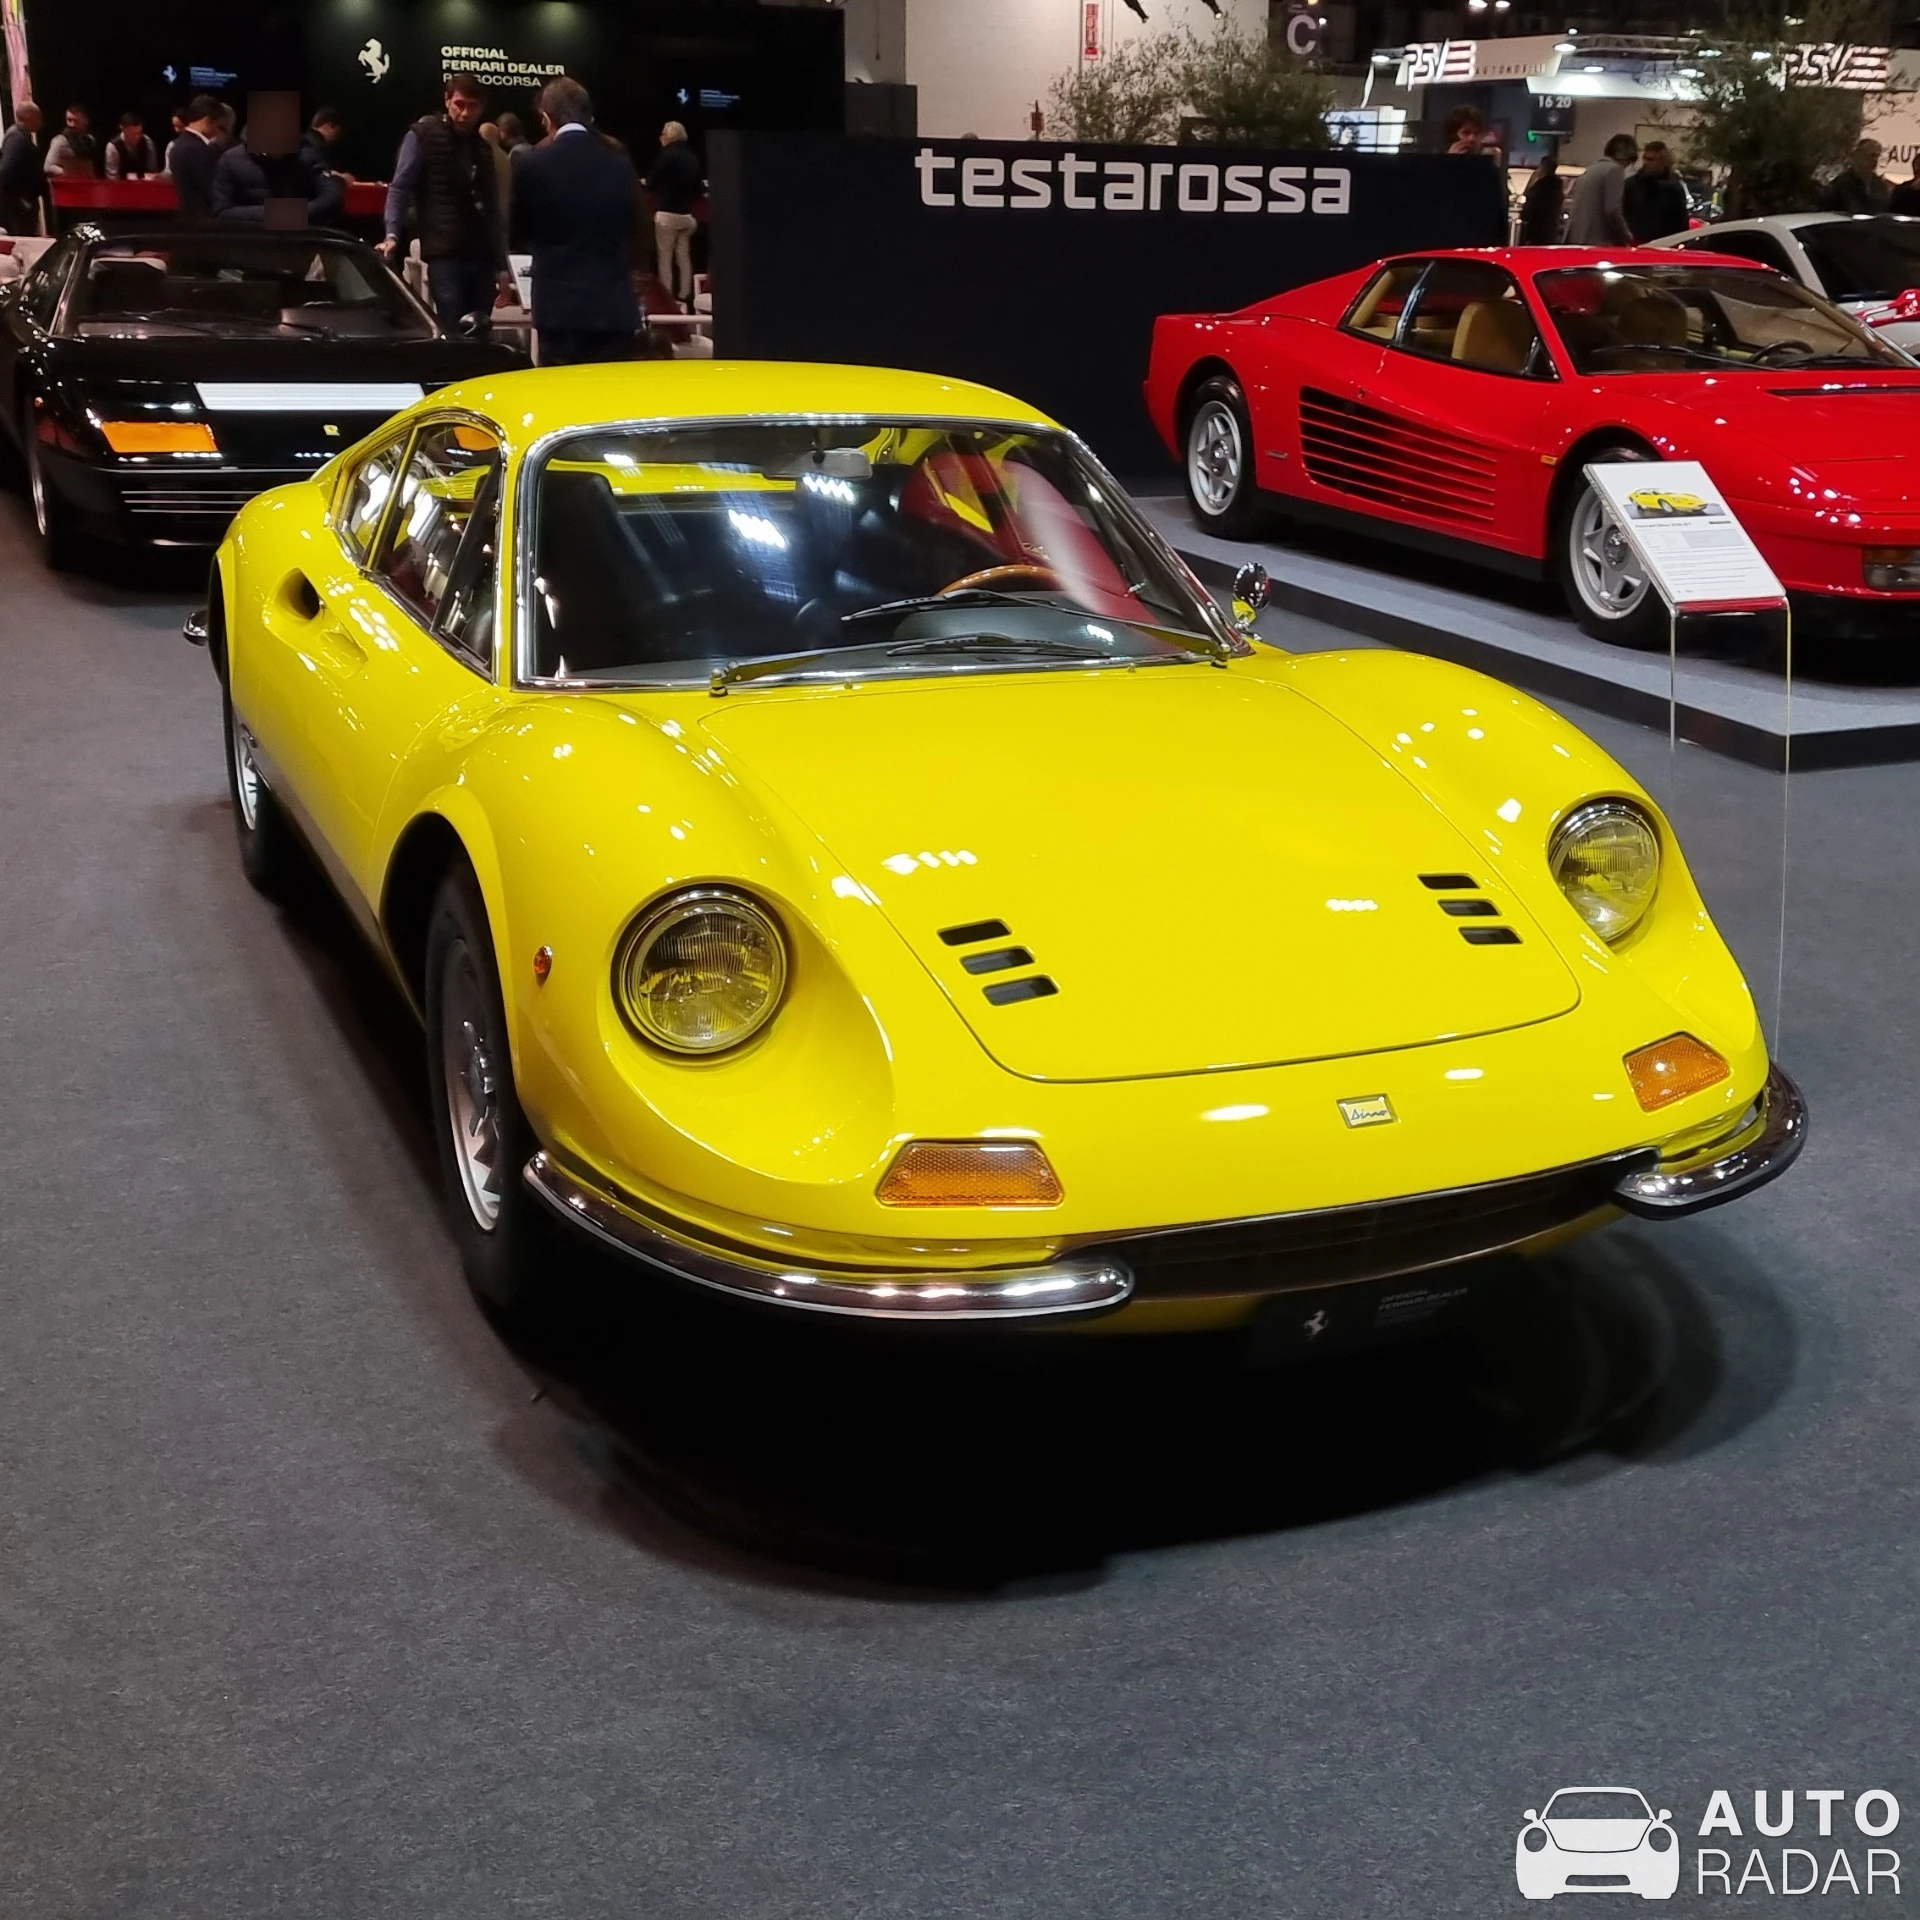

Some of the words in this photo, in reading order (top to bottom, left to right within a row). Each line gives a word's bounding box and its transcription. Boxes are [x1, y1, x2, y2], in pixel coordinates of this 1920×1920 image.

[1287, 14, 1316, 54] C
[441, 46, 508, 60] OFFICIAL
[442, 60, 505, 73] FERRARI
[508, 63, 565, 75] DEALER
[914, 147, 1351, 214] testarossa
[1350, 1108, 1388, 1121] Dino
